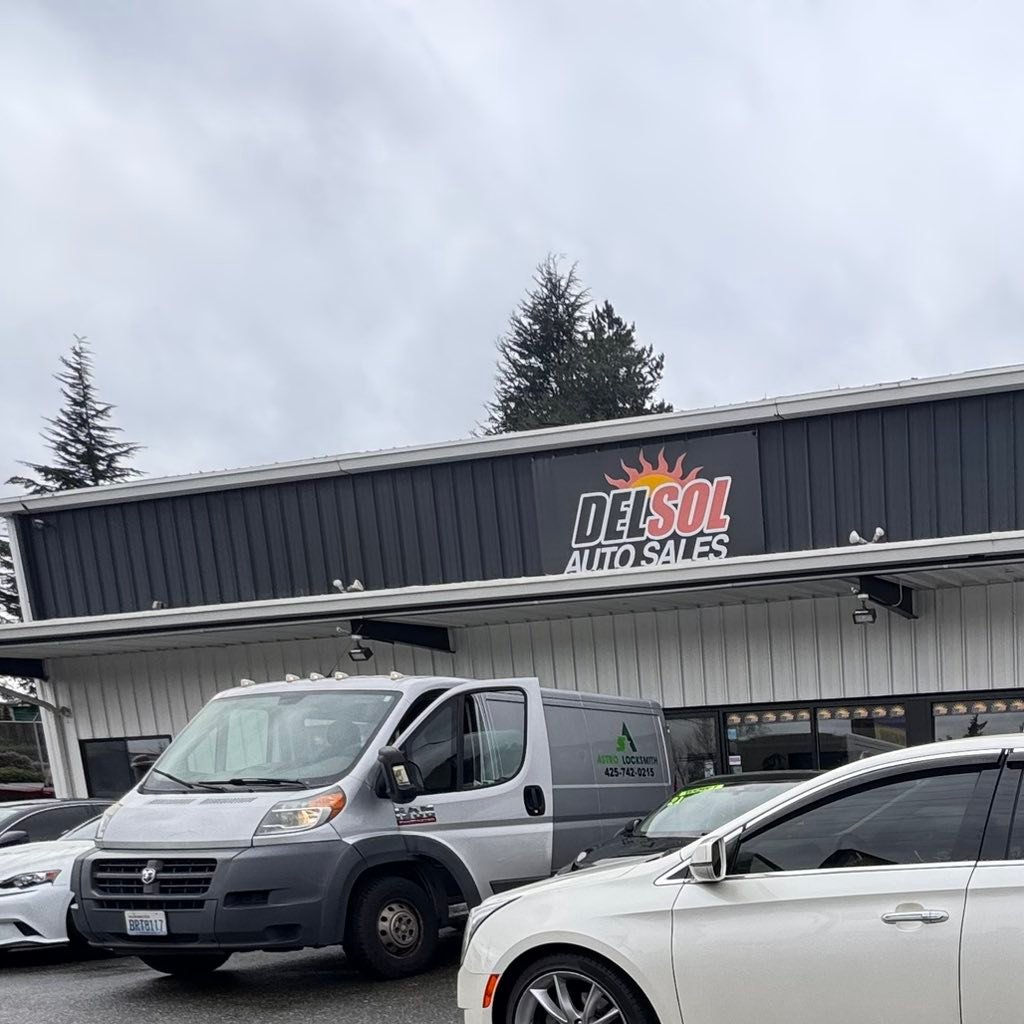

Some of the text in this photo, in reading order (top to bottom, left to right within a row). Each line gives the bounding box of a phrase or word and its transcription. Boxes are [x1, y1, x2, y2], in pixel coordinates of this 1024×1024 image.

[564, 533, 729, 574] AUTO SALES
[621, 755, 658, 765] LOCKSMITH
[604, 767, 655, 777] 425-742-0215
